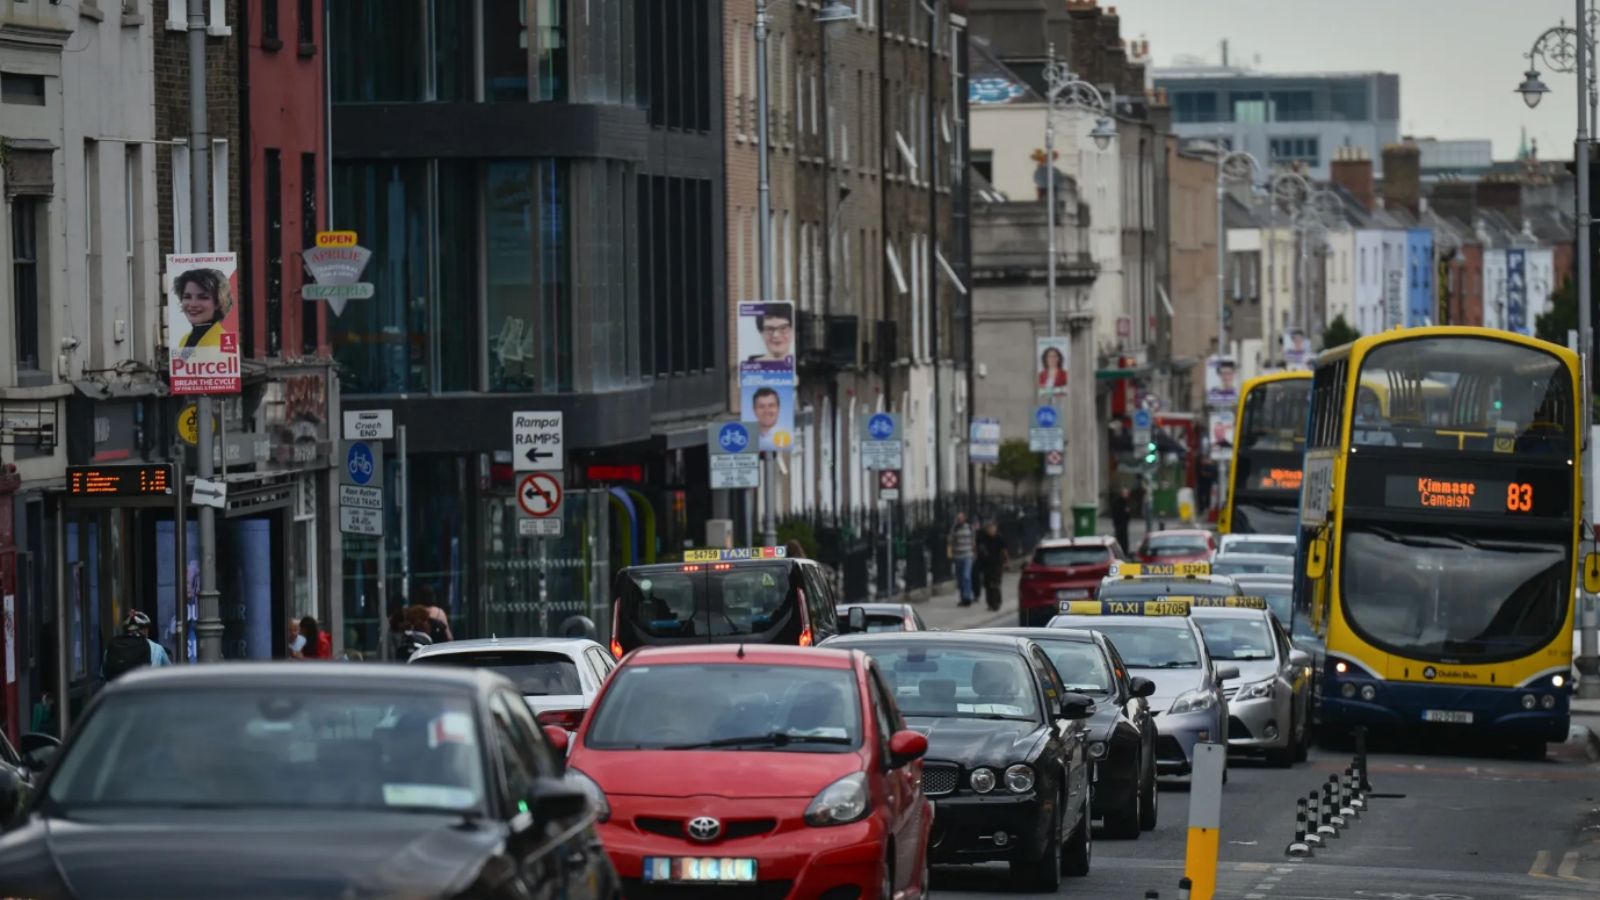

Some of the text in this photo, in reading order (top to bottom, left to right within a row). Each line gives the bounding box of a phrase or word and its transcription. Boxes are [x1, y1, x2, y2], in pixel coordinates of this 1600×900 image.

[319, 234, 353, 244] OPEN
[304, 286, 369, 297] PIZZERIA
[225, 335, 232, 345] 1
[171, 356, 238, 375] Purcell
[515, 433, 560, 445] RAMPS
[1417, 477, 1533, 512] Kimmage 83
[1420, 491, 1470, 508] Camaigh
[342, 496, 380, 506] CYCLE TRACK
[694, 547, 749, 559] 54759 TAXI
[1146, 564, 1174, 575] TAXI
[1107, 602, 1139, 613] TAXI
[1155, 601, 1184, 614] 41705
[1196, 597, 1224, 607] TAXI
[1438, 670, 1478, 679] Dublin Bus
